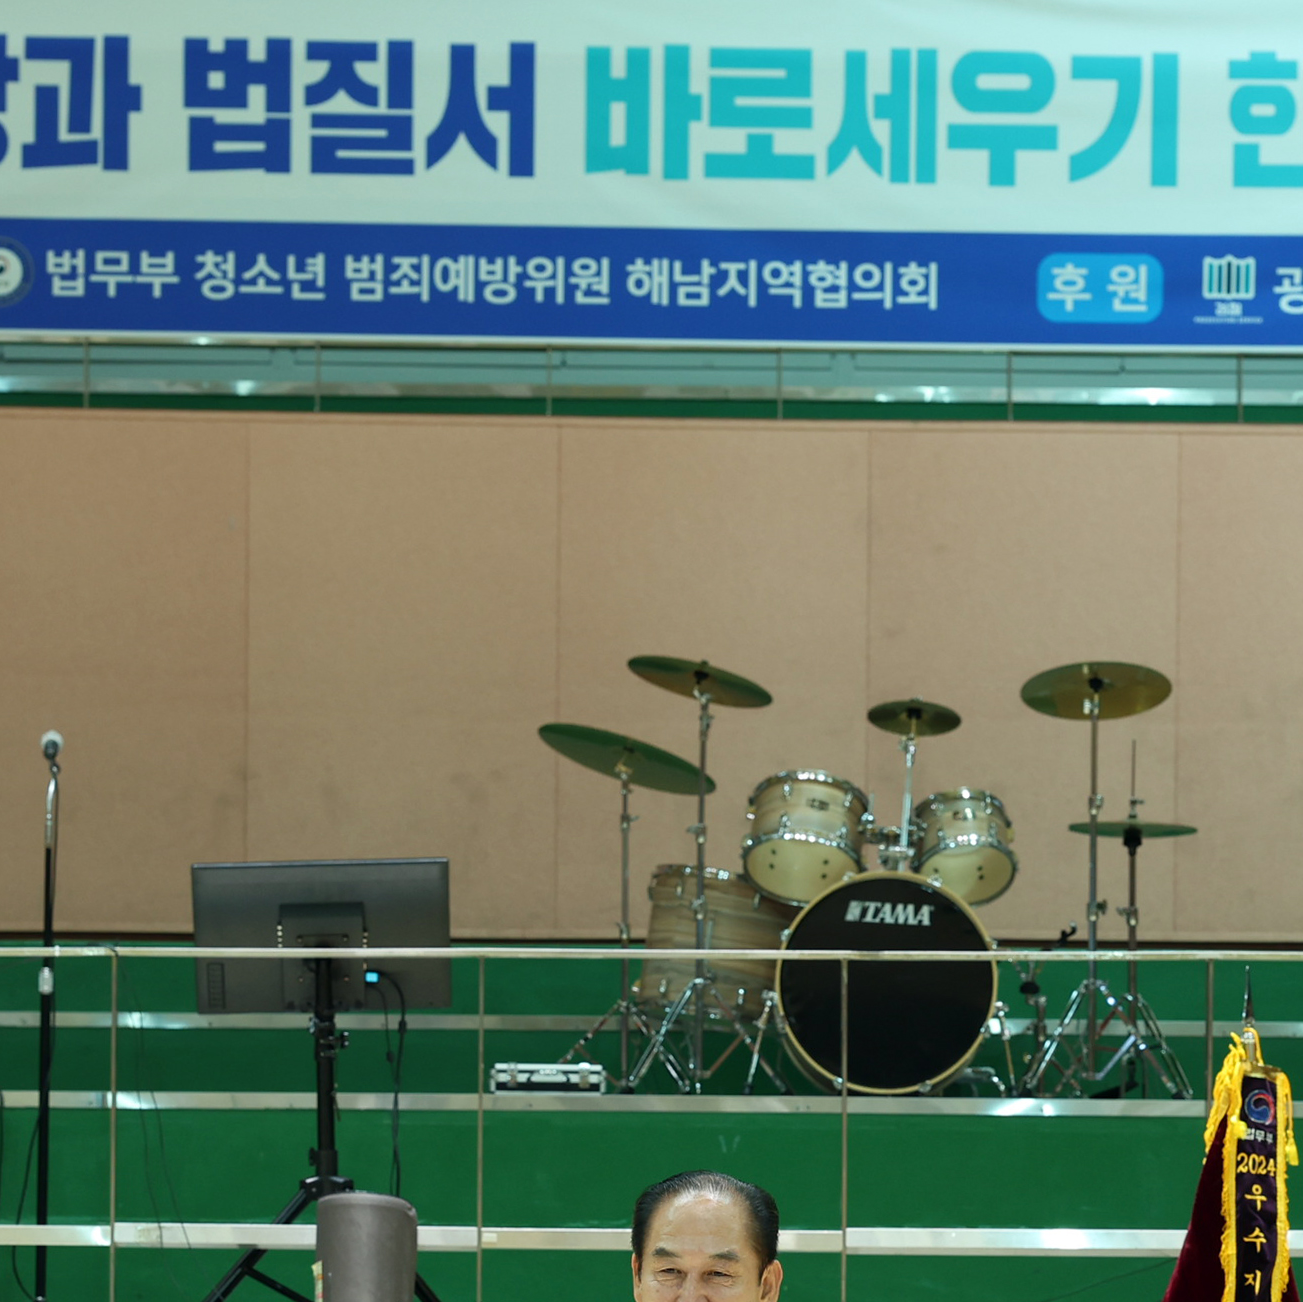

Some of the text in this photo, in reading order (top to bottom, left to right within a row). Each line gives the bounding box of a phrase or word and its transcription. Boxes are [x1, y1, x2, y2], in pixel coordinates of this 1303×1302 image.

[183, 37, 536, 178] 법질서
[584, 44, 1179, 187] 바로세우기
[45, 249, 179, 298] 법무부
[195, 250, 326, 301] 청소년
[345, 253, 610, 306] 범죄예방위원
[626, 257, 939, 311] 해남지역협의회
[861, 901, 932, 927] TAMA
[1236, 1152, 1277, 1177] 2024
